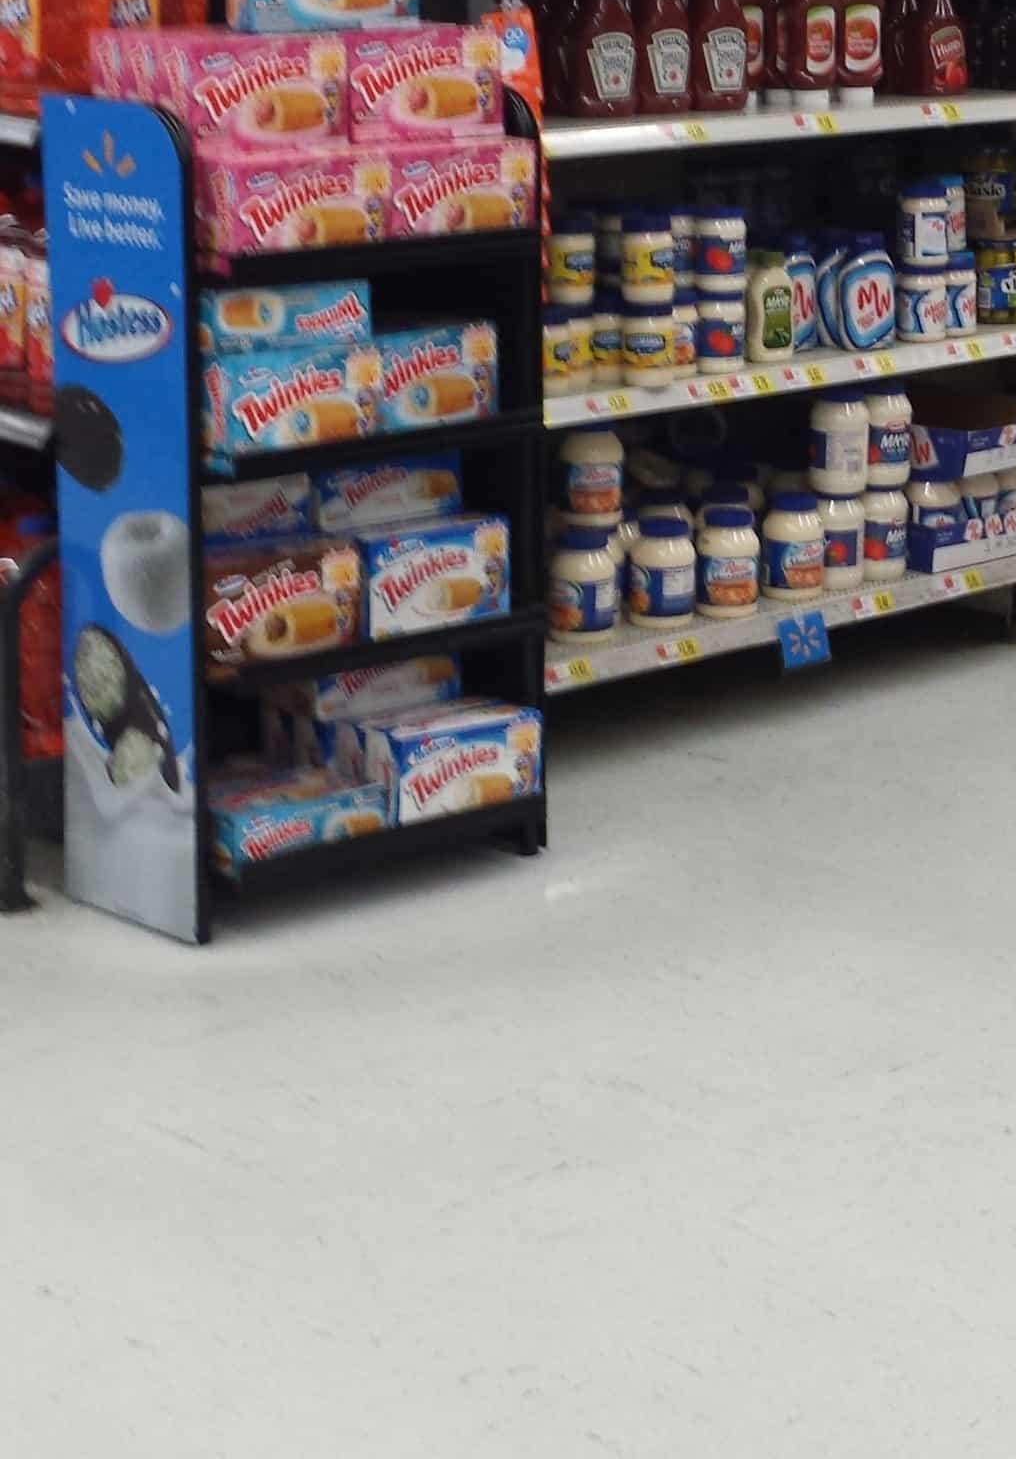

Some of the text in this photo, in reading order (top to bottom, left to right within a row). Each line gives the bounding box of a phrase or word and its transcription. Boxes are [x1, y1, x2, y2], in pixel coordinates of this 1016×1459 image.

[194, 53, 306, 121] Twinkies
[351, 42, 459, 109] Twinkies
[64, 181, 101, 212] Save
[239, 171, 350, 242] Twinkies
[394, 158, 499, 228] Twinkies
[231, 364, 343, 438] Twinkies
[383, 341, 461, 401] winkies
[206, 568, 321, 646] Twinkies
[373, 549, 468, 613] Twinkies
[404, 745, 499, 812] Twinkies
